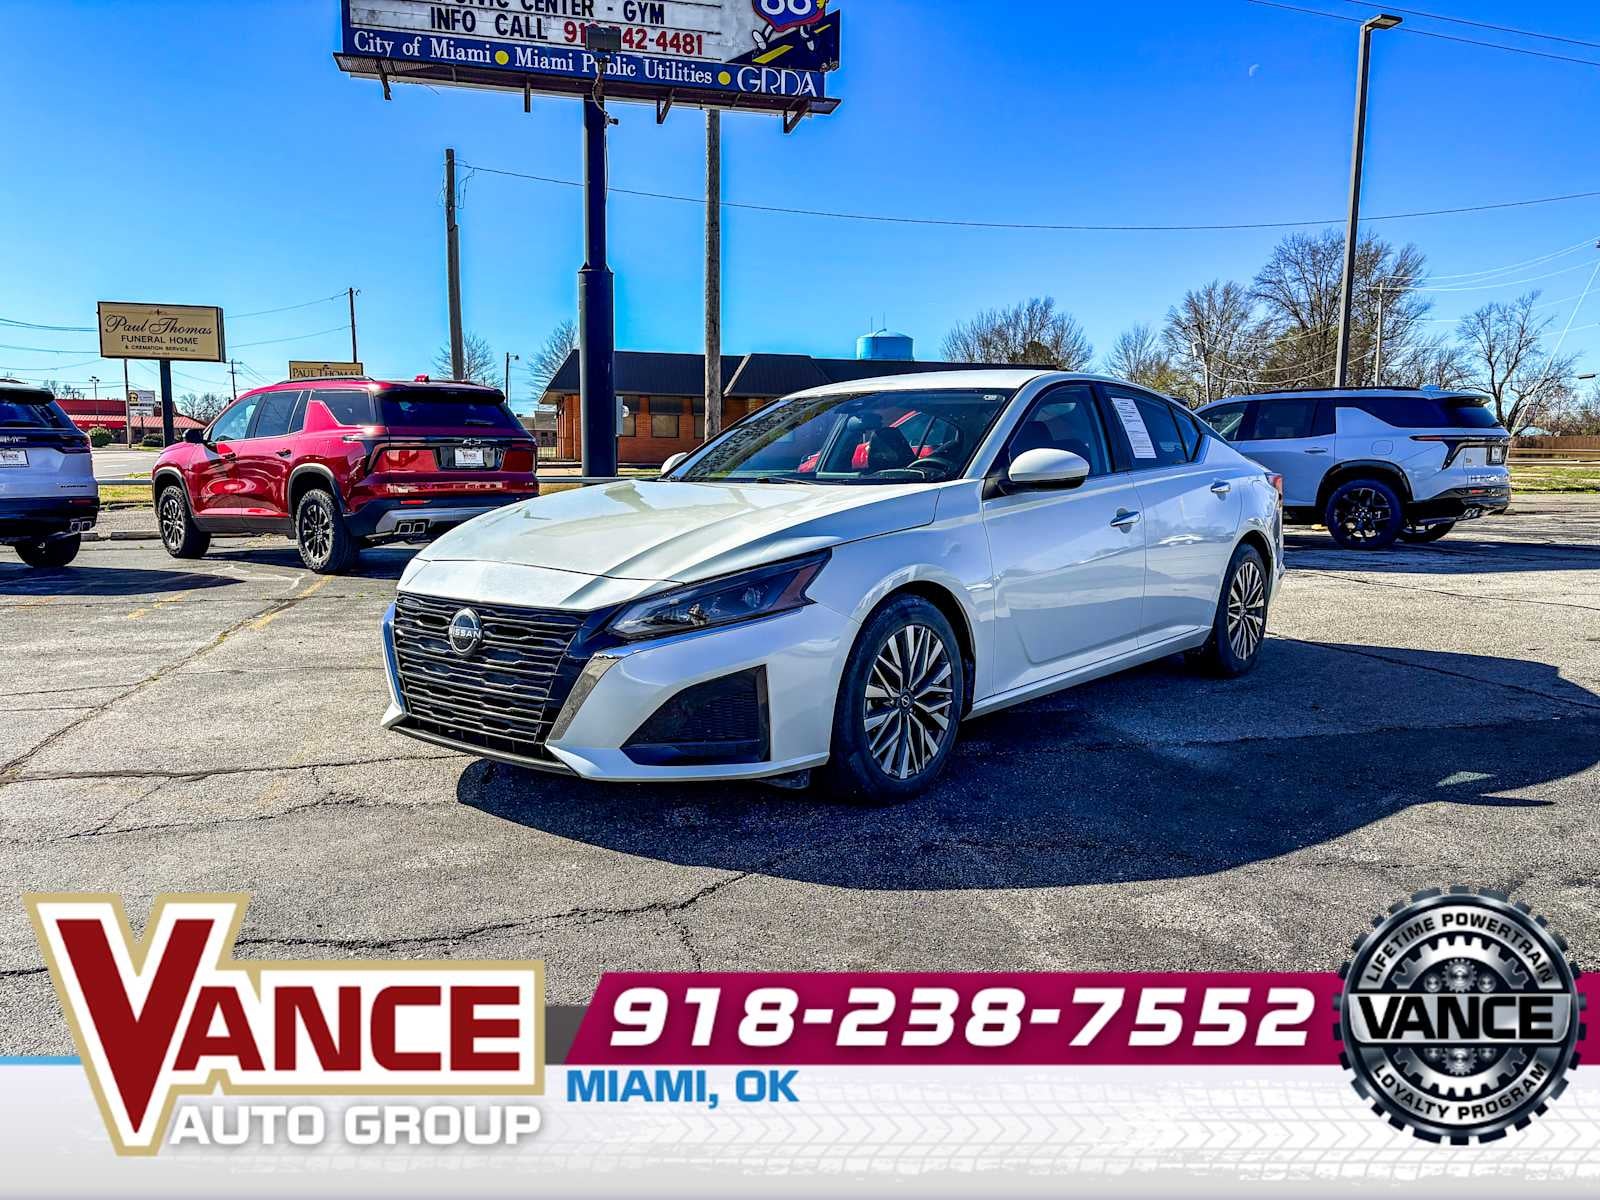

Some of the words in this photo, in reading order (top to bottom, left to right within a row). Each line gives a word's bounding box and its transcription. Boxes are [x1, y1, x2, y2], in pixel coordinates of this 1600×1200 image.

[430, 6, 476, 33] INFO
[494, 13, 548, 40] CALL
[623, 0, 665, 25] GYM
[353, 30, 394, 57] City
[402, 36, 422, 57] of
[429, 37, 492, 64] Miami
[514, 46, 575, 72] Miami
[642, 59, 713, 84] Utilities
[736, 66, 817, 97] GRDA
[104, 314, 149, 333] Paul
[148, 317, 212, 335] Thomas
[121, 335, 166, 344] FUNERAL
[169, 336, 199, 345] HOME
[292, 367, 315, 378] PAUL
